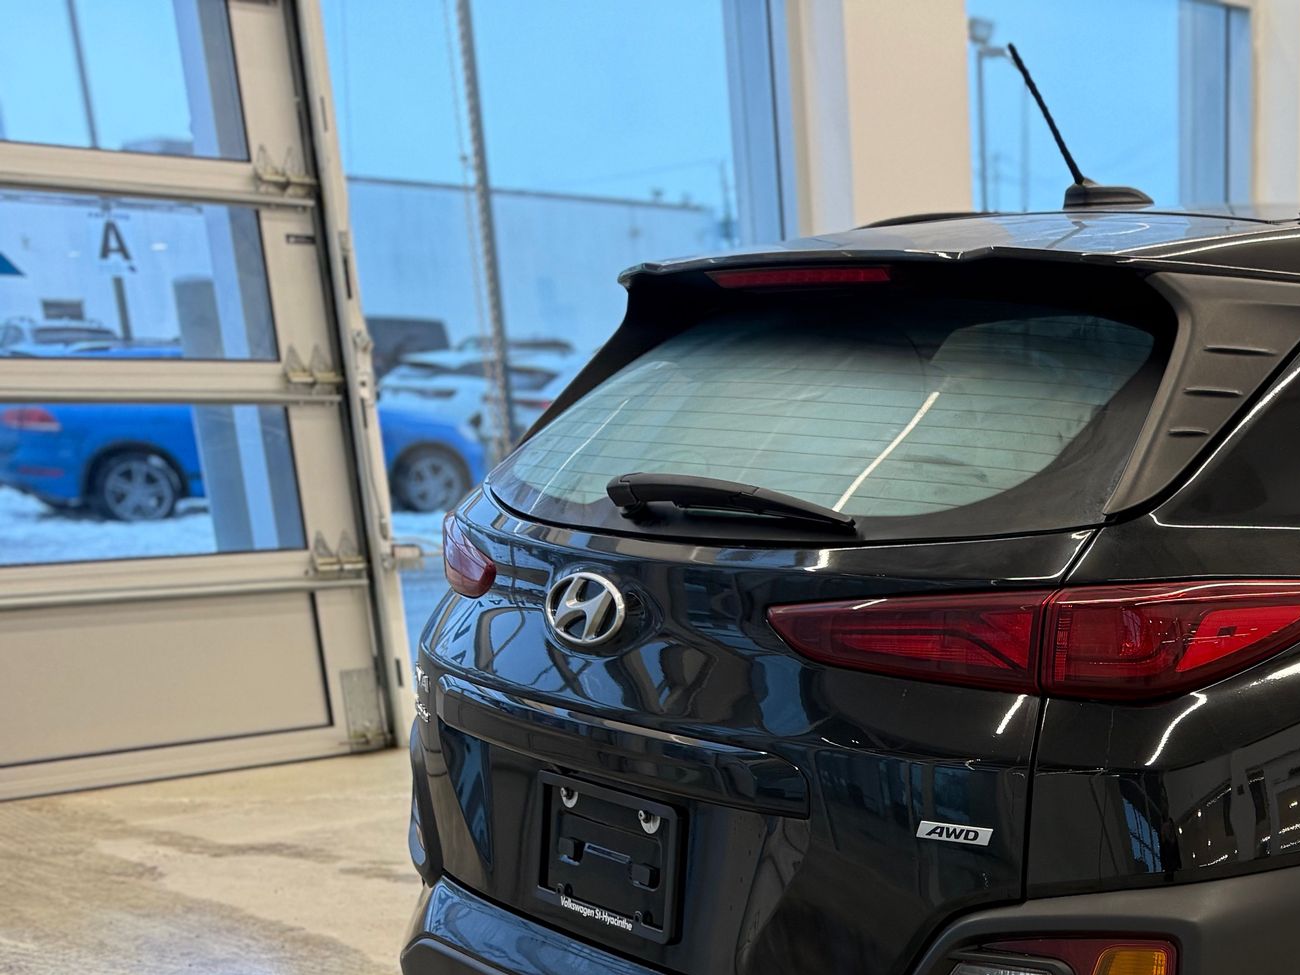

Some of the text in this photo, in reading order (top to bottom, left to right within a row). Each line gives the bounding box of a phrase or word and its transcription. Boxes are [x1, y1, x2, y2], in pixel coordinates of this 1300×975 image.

[925, 826, 979, 841] AWD
[560, 895, 633, 931] Volkswagen St-Hyacinthe
